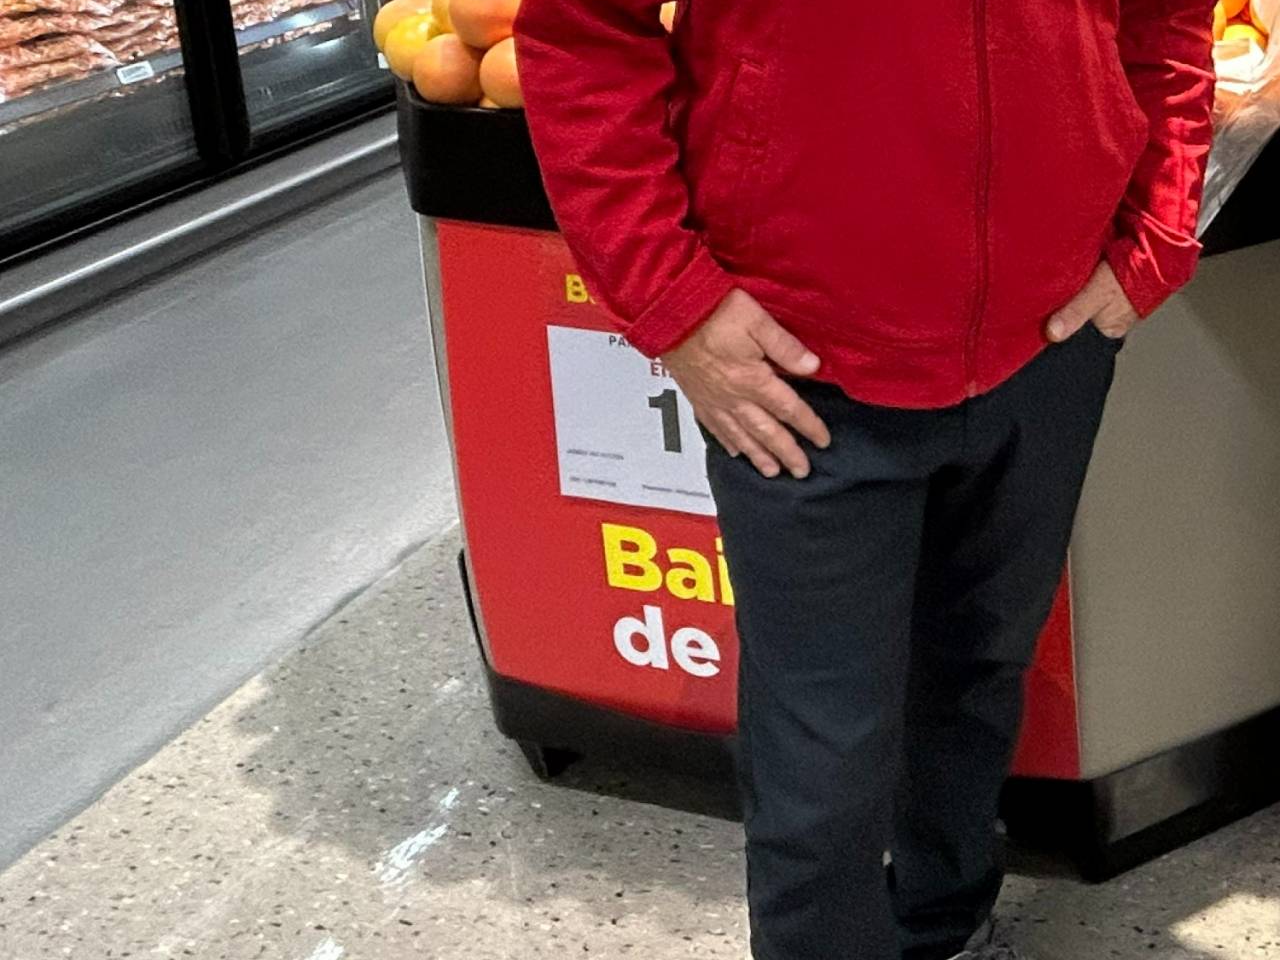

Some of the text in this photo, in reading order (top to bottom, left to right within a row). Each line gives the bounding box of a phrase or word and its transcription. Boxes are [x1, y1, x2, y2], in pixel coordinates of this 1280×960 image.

[565, 273, 596, 304] B
[648, 388, 682, 453] 1
[613, 604, 721, 678] de
